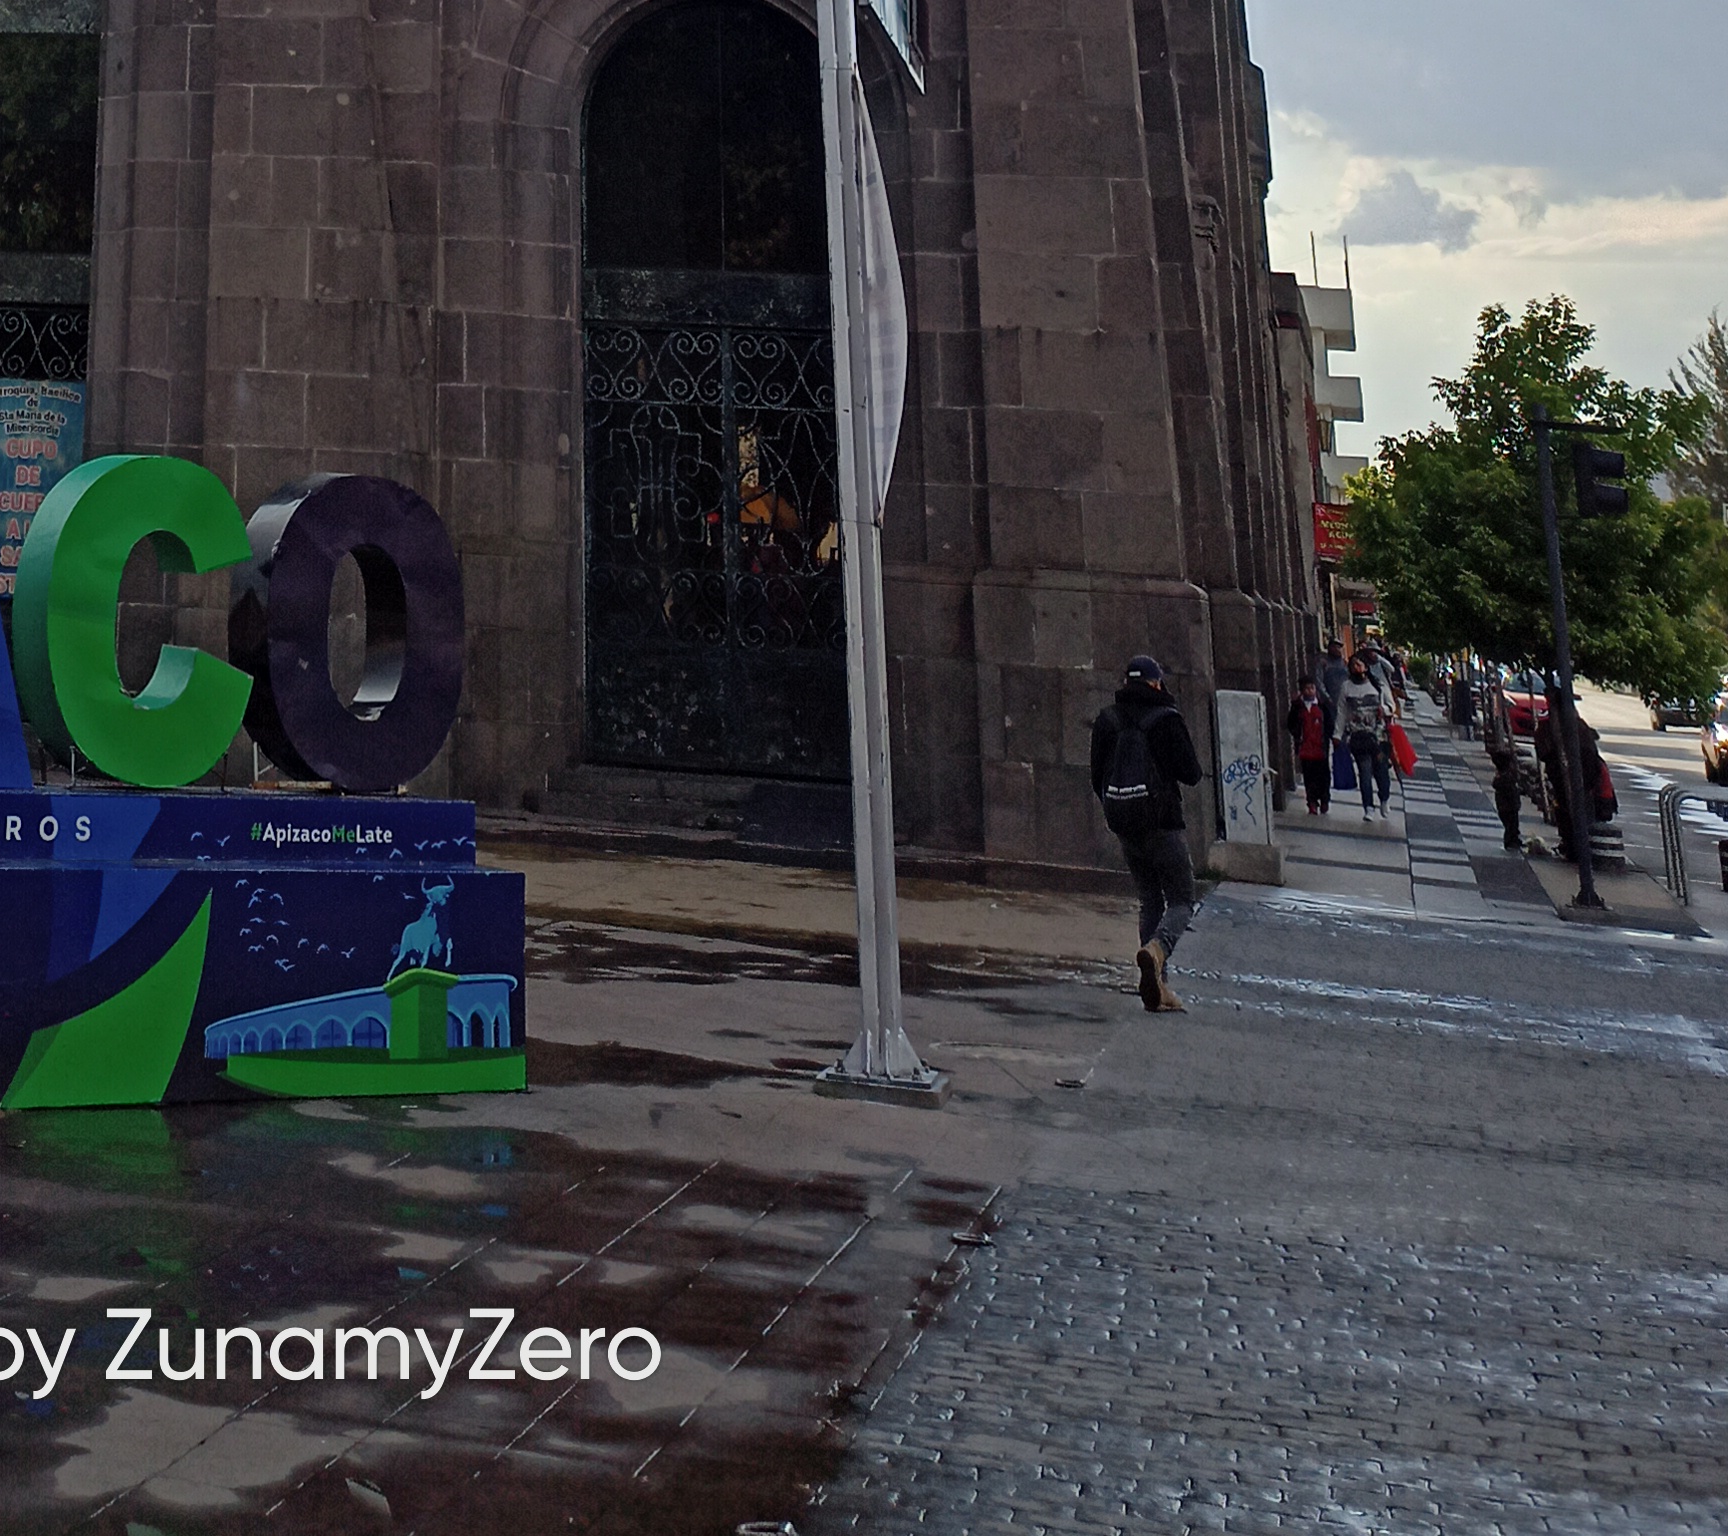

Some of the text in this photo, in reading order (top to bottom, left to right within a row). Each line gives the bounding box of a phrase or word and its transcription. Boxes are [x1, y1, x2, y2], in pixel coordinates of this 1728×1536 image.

[26, 397, 39, 408] de
[44, 412, 57, 422] de
[5, 423, 61, 436] Misericordia
[5, 439, 59, 459] CUPO
[15, 465, 41, 486] DE
[5, 517, 21, 540] A
[249, 821, 394, 849] #ApizacoMeLate
